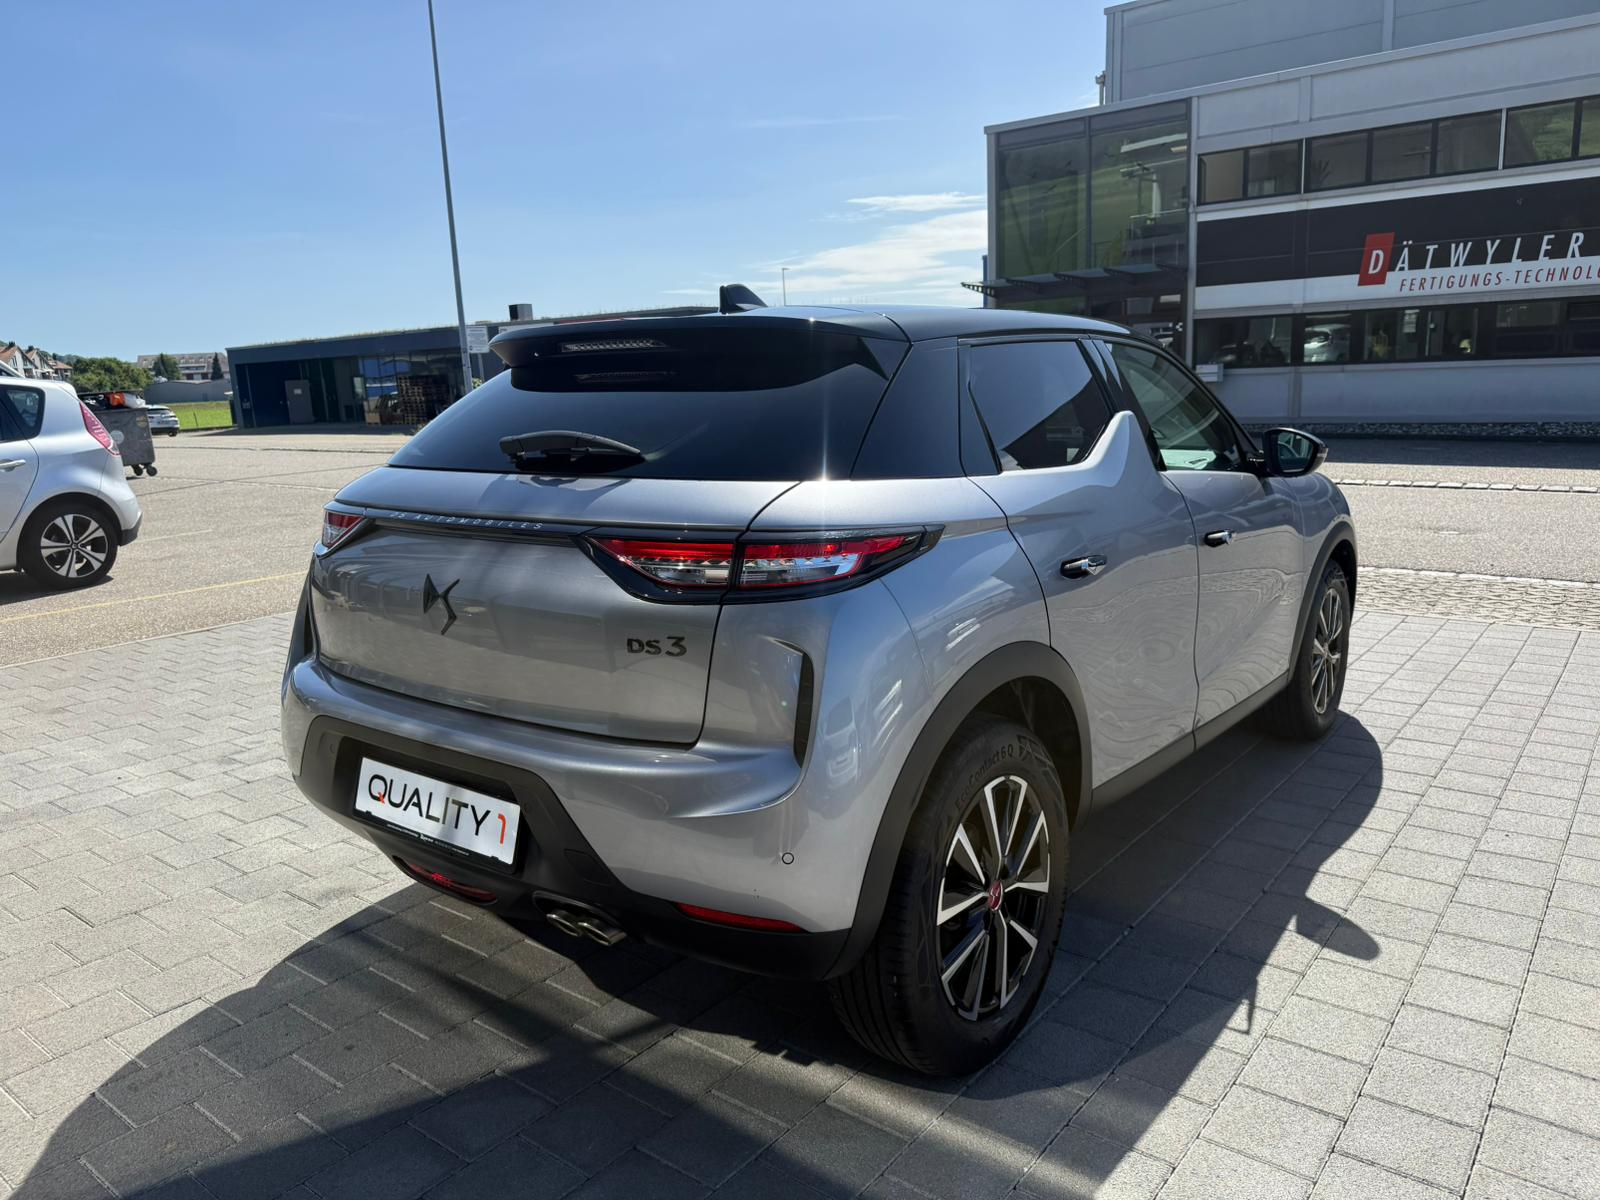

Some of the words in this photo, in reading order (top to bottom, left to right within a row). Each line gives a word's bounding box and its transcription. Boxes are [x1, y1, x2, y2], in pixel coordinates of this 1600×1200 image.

[1368, 231, 1585, 275] DÄTWYLER
[414, 514, 544, 529] AUTOMOBILES
[368, 774, 491, 836] QUALITY
[497, 813, 507, 844] 1
